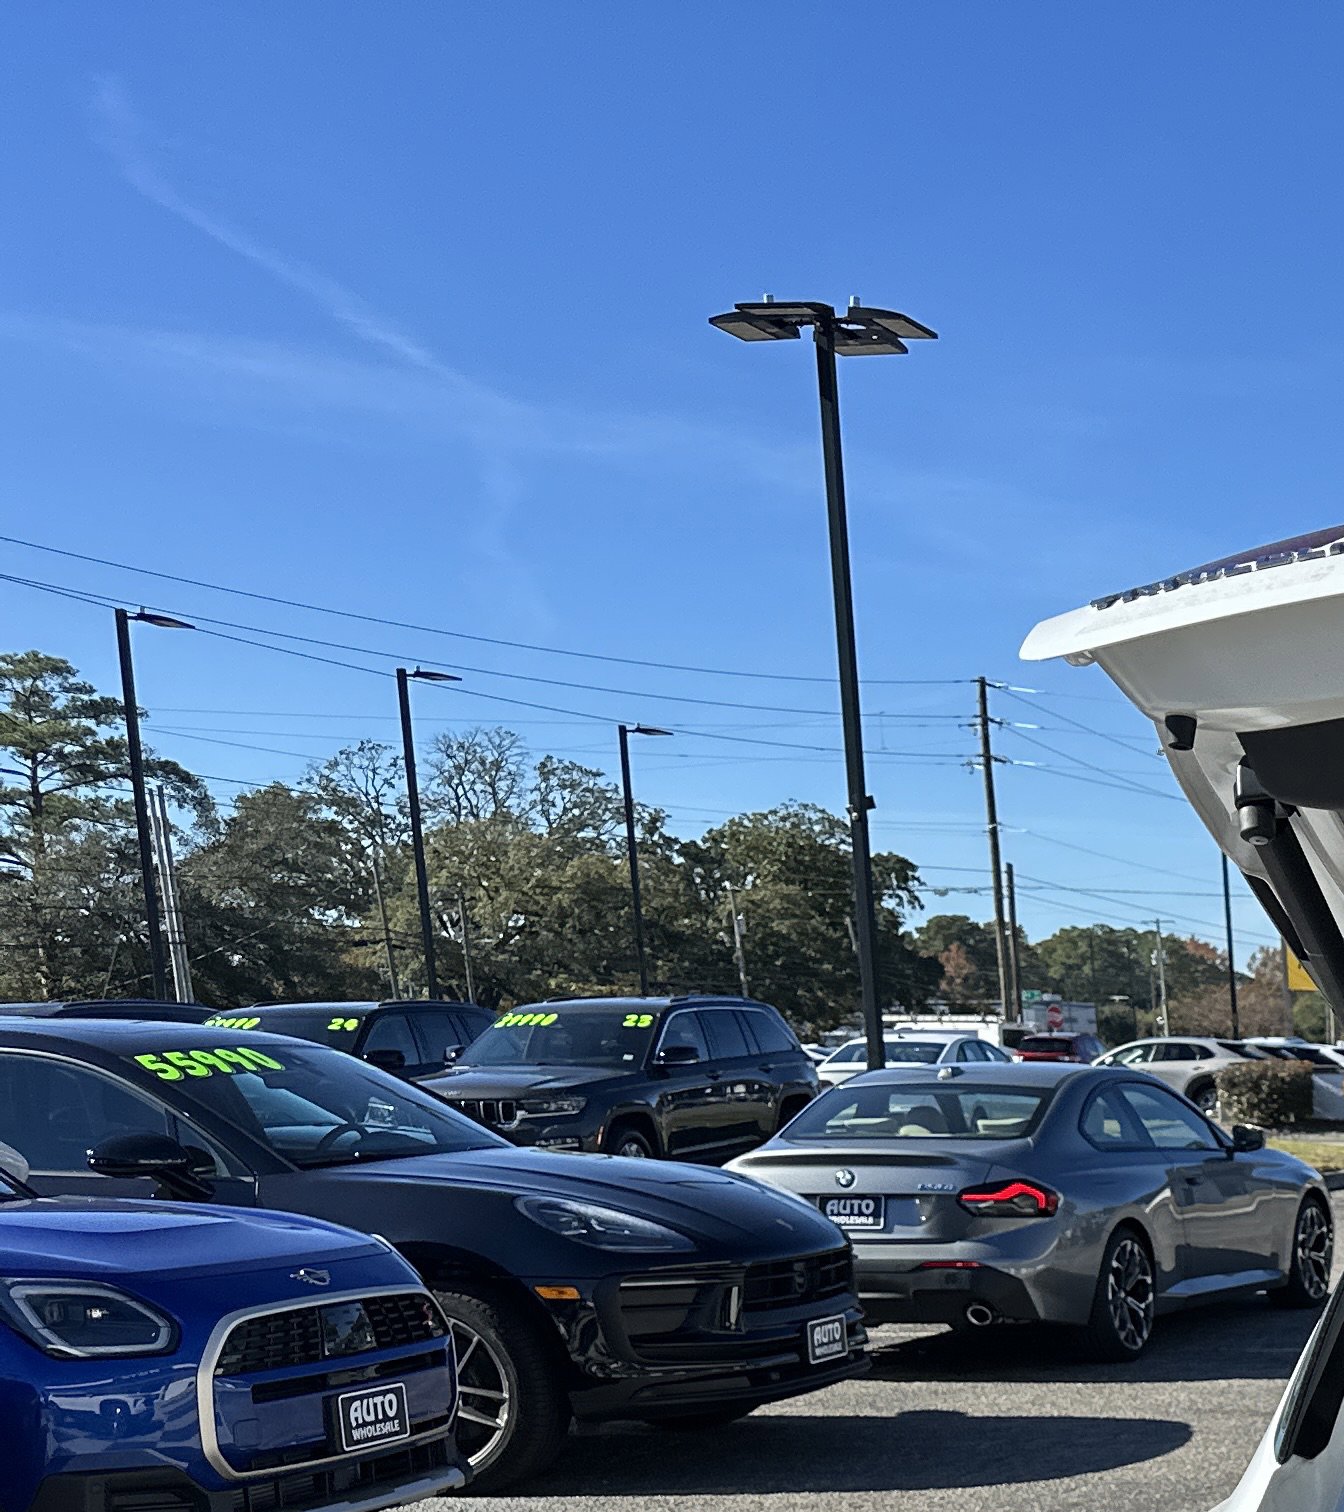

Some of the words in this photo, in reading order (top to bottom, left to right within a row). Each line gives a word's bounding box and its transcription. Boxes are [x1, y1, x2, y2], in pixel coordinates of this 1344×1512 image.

[134, 1047, 286, 1082] 55990
[826, 1199, 875, 1216] AUTO
[814, 1322, 841, 1346] AUTO
[349, 1393, 398, 1428] AUTO
[351, 1419, 400, 1441] WHOLESALE
